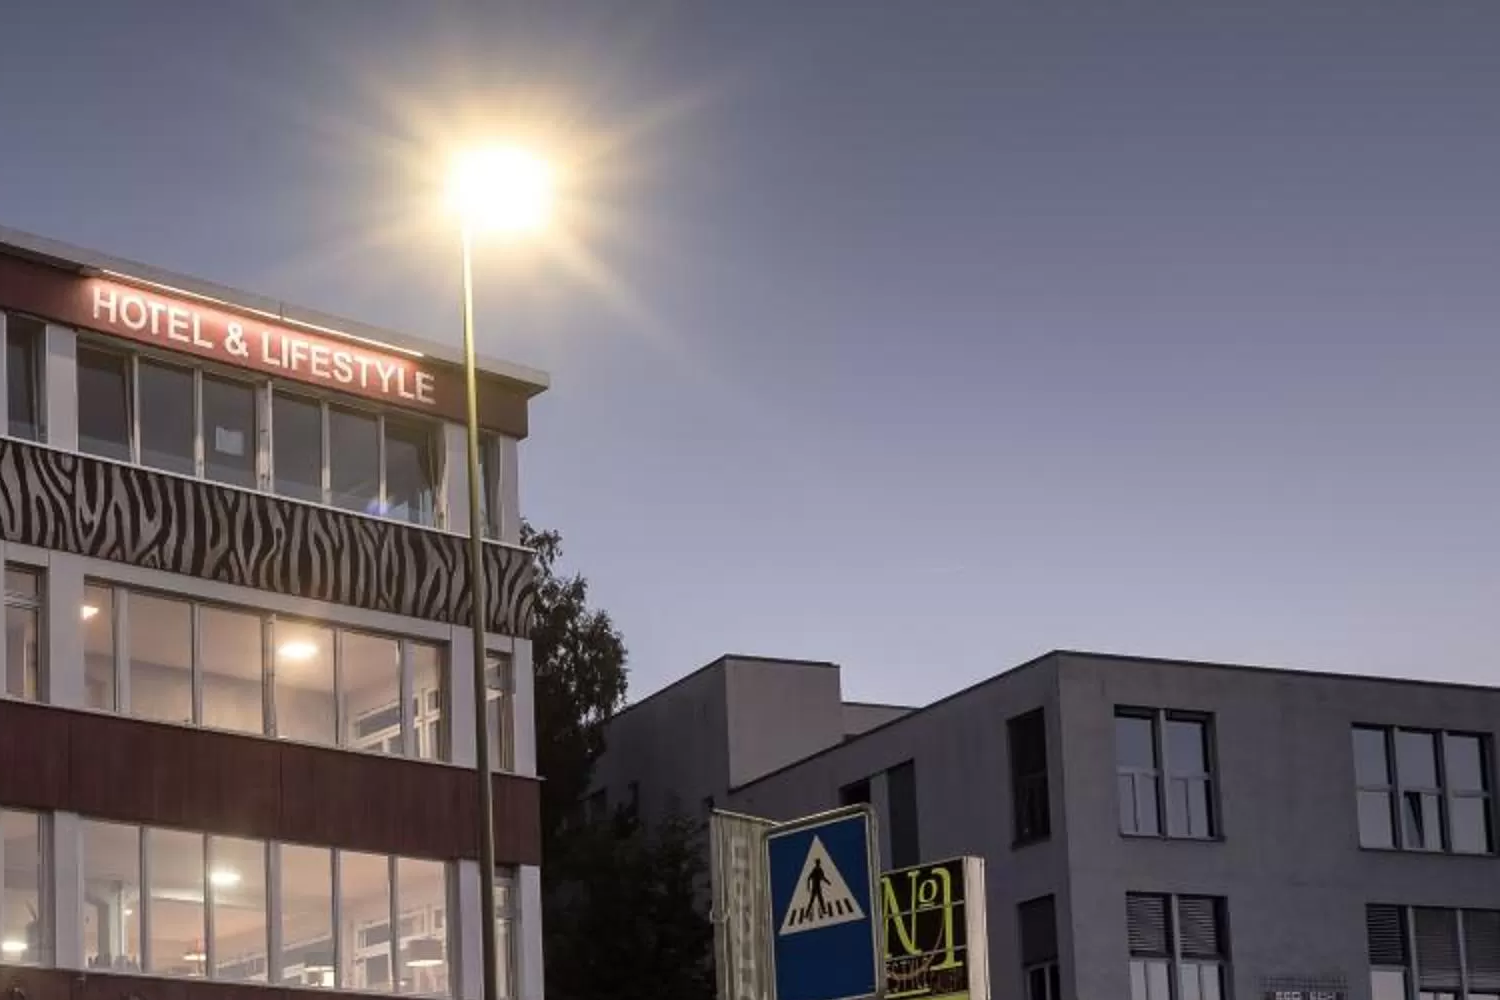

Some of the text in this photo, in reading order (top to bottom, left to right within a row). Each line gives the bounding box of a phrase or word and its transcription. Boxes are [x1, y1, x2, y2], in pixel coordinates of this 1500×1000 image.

[92, 286, 436, 405] HOTEL & LIFESTYLE
